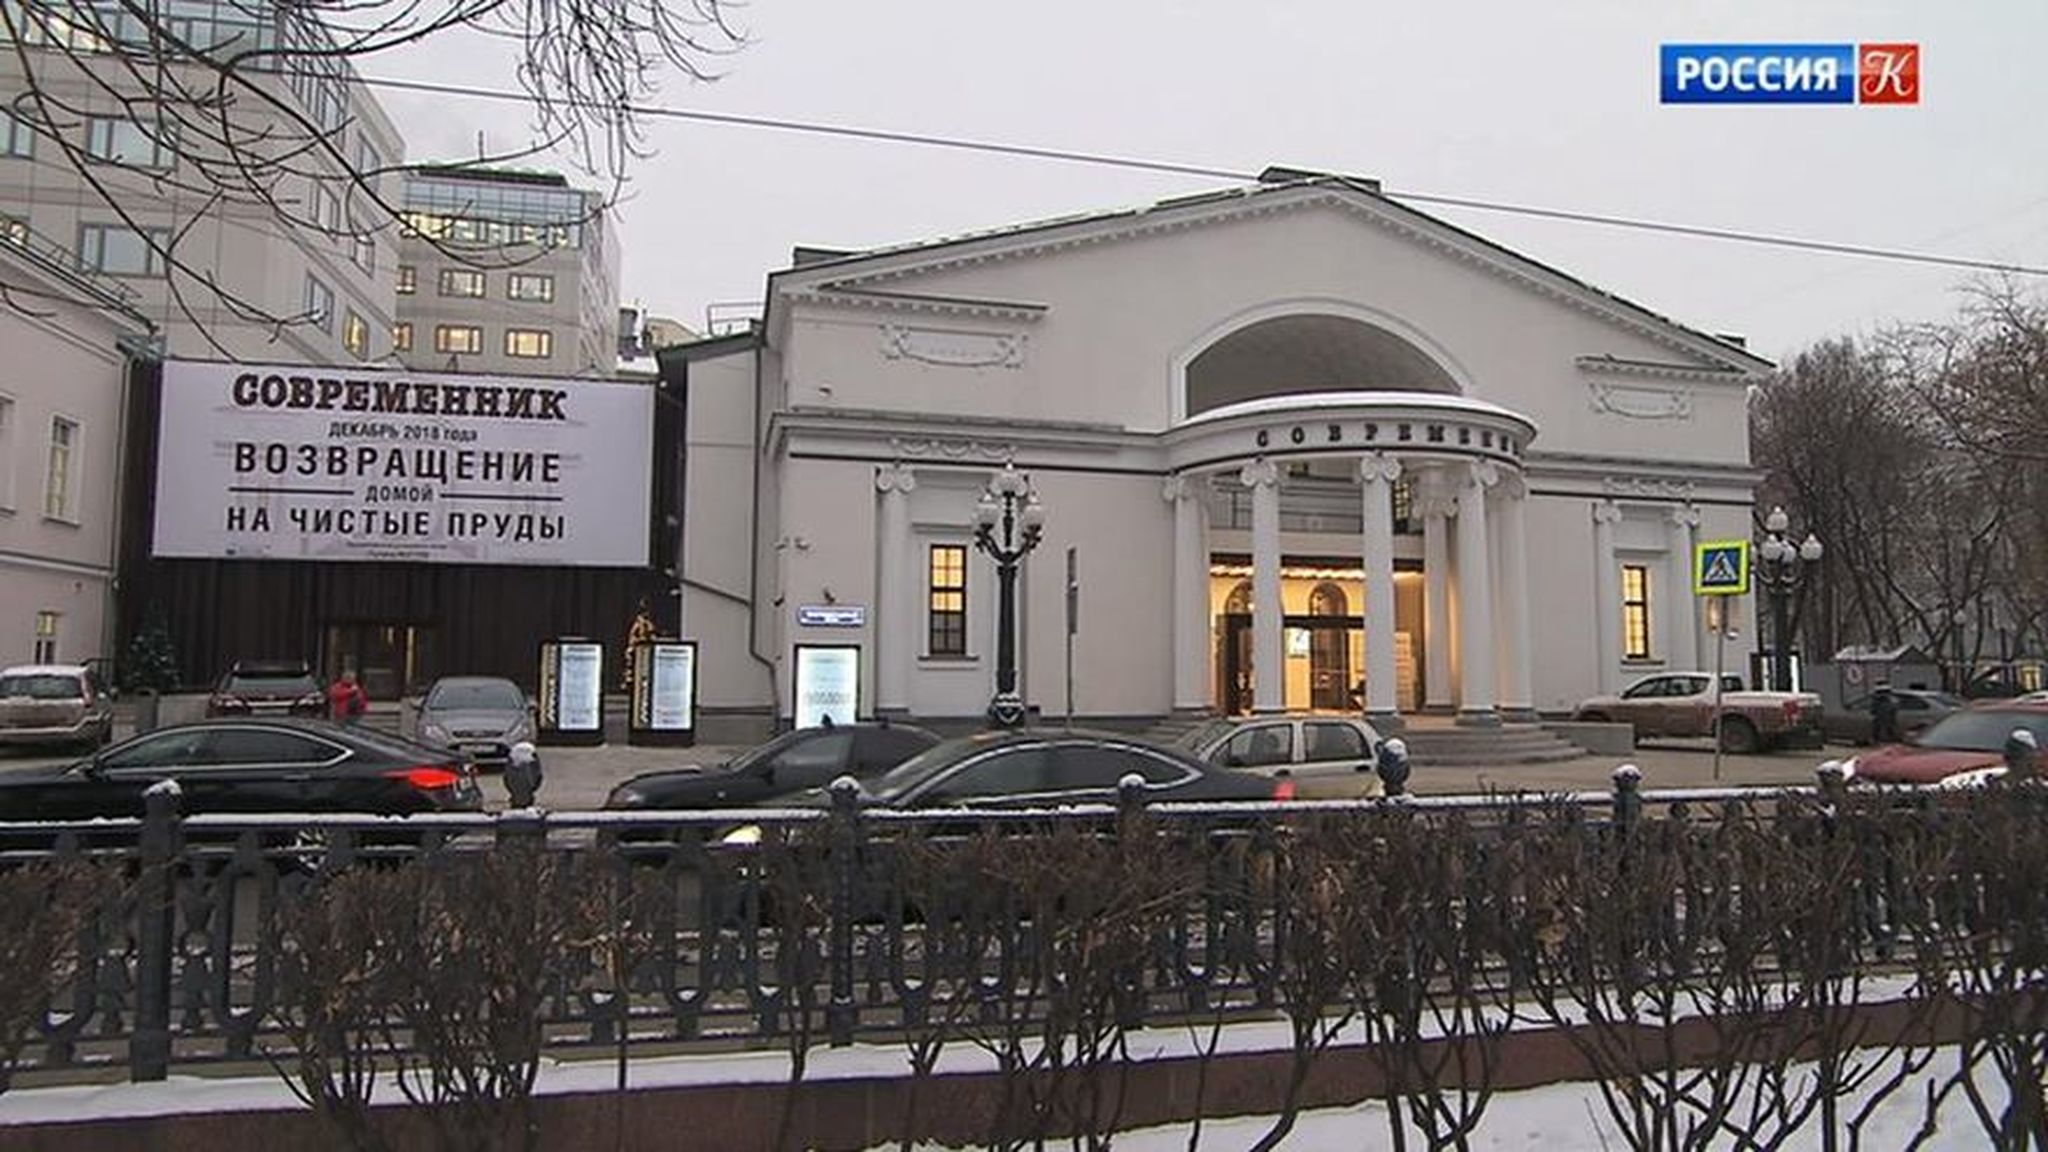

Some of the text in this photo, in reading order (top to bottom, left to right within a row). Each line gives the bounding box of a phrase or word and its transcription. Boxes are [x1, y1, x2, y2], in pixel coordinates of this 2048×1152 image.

[233, 374, 568, 420] СОВРЕМЕННИК
[329, 422, 478, 442] ДЕКАБРЬ 2018 года
[234, 443, 561, 483] ВОЗВРАЩЕНИЕ
[365, 484, 433, 503] ДОМОЙ
[227, 506, 564, 542] НА ЧИСТЫЕ ПРУДЫ
